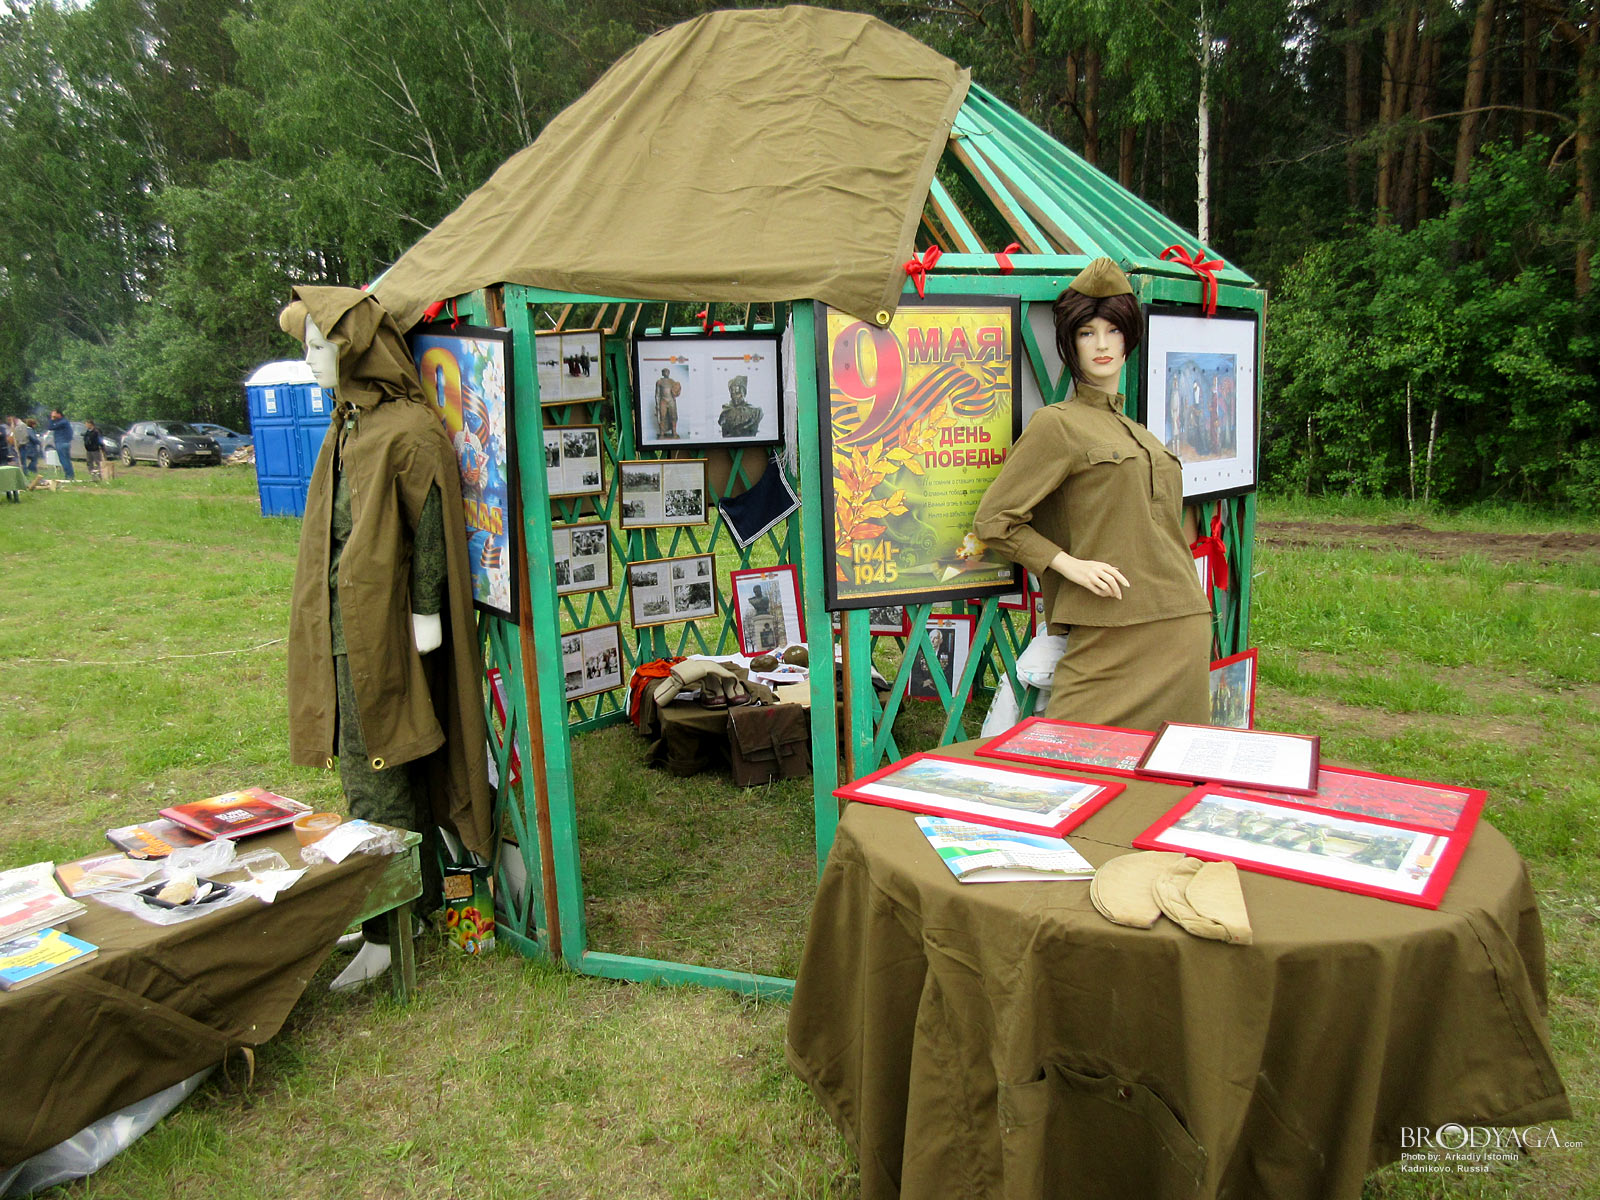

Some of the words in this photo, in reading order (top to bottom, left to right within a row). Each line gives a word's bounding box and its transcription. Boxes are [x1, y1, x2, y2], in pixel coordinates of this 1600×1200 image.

[832, 320, 904, 444] 9
[907, 326, 1004, 363] МАЯ
[940, 426, 991, 447] ДЕНЬ
[925, 448, 1007, 469] ПОБЕДЫ
[463, 498, 503, 536] МАЯ
[853, 539, 900, 563] 1941-
[854, 561, 898, 585] 1945
